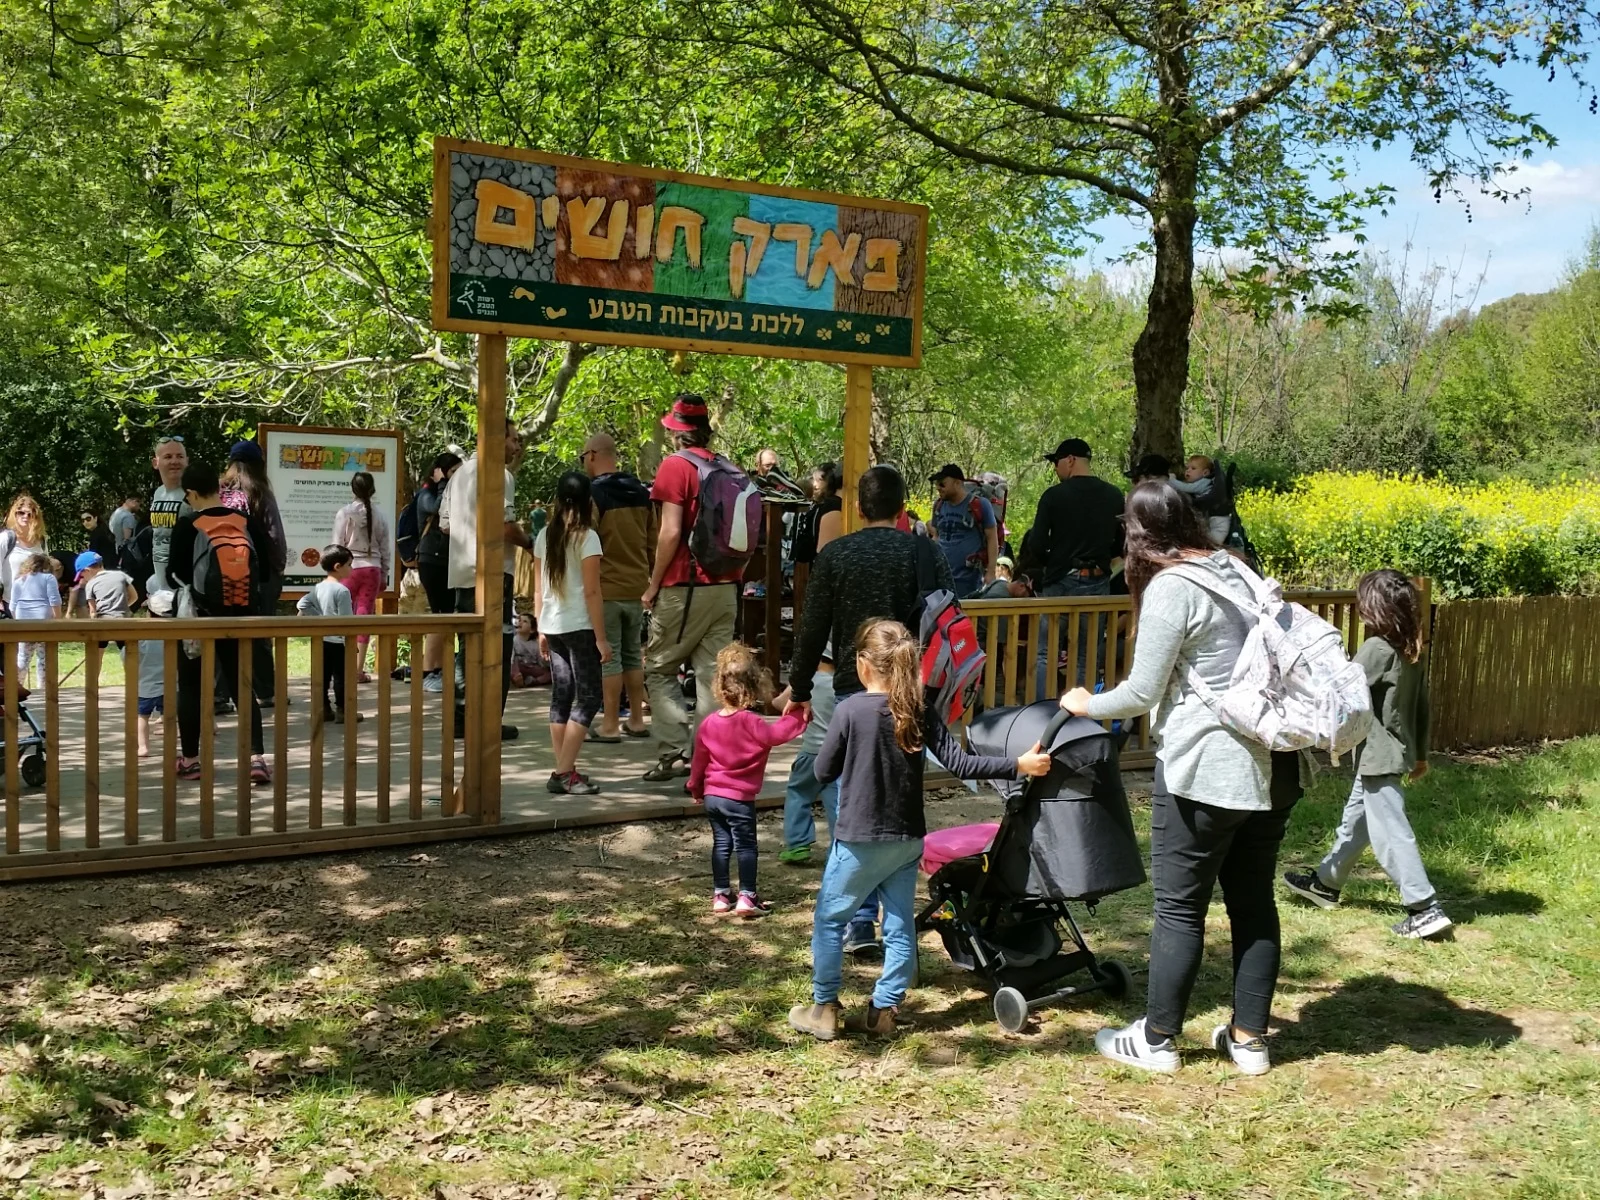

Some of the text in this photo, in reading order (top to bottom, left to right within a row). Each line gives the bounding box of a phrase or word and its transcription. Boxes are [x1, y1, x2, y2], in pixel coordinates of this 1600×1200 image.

[475, 179, 902, 298] פארק חושים
[588, 298, 805, 335] ללכת בעקבות הטבע
[282, 448, 383, 468] פארק חושים
